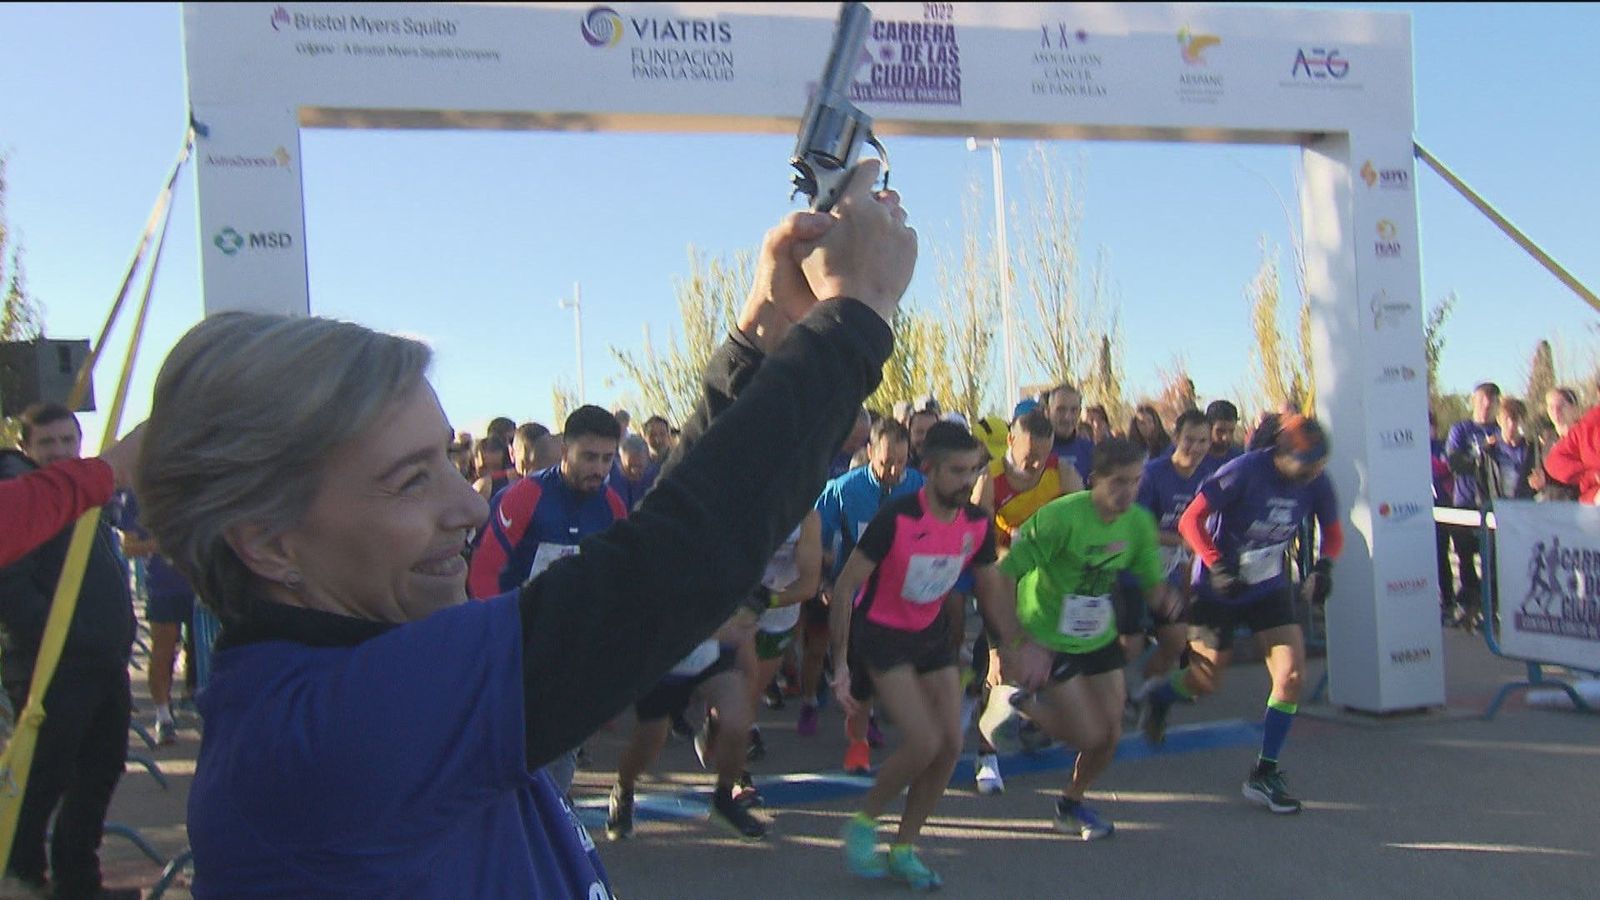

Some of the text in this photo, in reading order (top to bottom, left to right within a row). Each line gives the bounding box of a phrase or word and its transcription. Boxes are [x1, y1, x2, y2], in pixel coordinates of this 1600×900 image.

[922, 3, 954, 19] 2022
[294, 13, 457, 38] Bristol Myers Squibb
[631, 17, 731, 43] VIATRIS
[872, 20, 955, 43] CARRERA
[901, 42, 959, 66] DE LAS
[633, 64, 735, 81] PARA LA SALUD
[870, 63, 961, 93] CIUDADES
[249, 231, 293, 248] MSD
